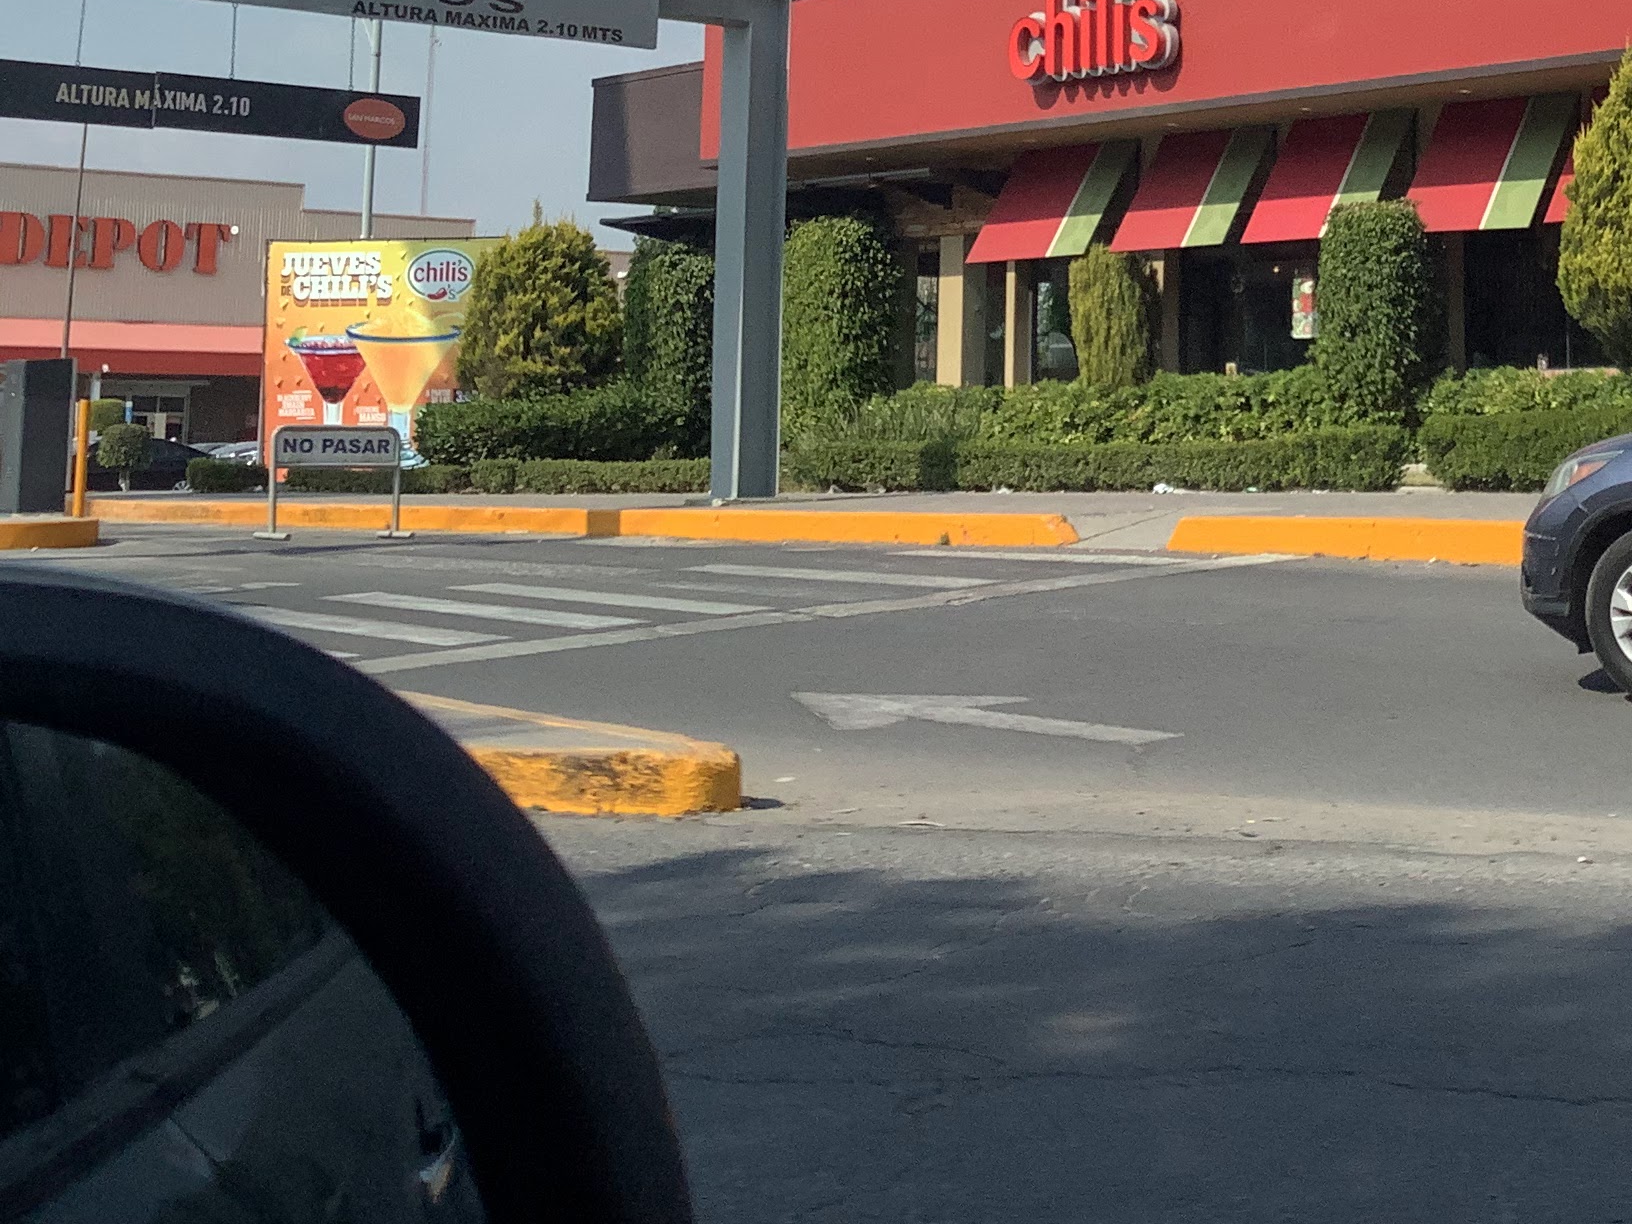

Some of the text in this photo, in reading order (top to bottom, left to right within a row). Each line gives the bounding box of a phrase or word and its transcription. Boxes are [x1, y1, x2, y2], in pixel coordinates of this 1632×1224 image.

[352, 0, 623, 43] ALTURA MAXIMA 2.10 MTS
[55, 82, 251, 117] ALTURA MÁXIMA 2.10
[0, 211, 231, 275] DEPOT
[281, 252, 381, 278] JUEVES
[413, 259, 468, 283] chili's
[280, 275, 393, 302] DE CHILI'S
[282, 437, 391, 455] NO PASAR
